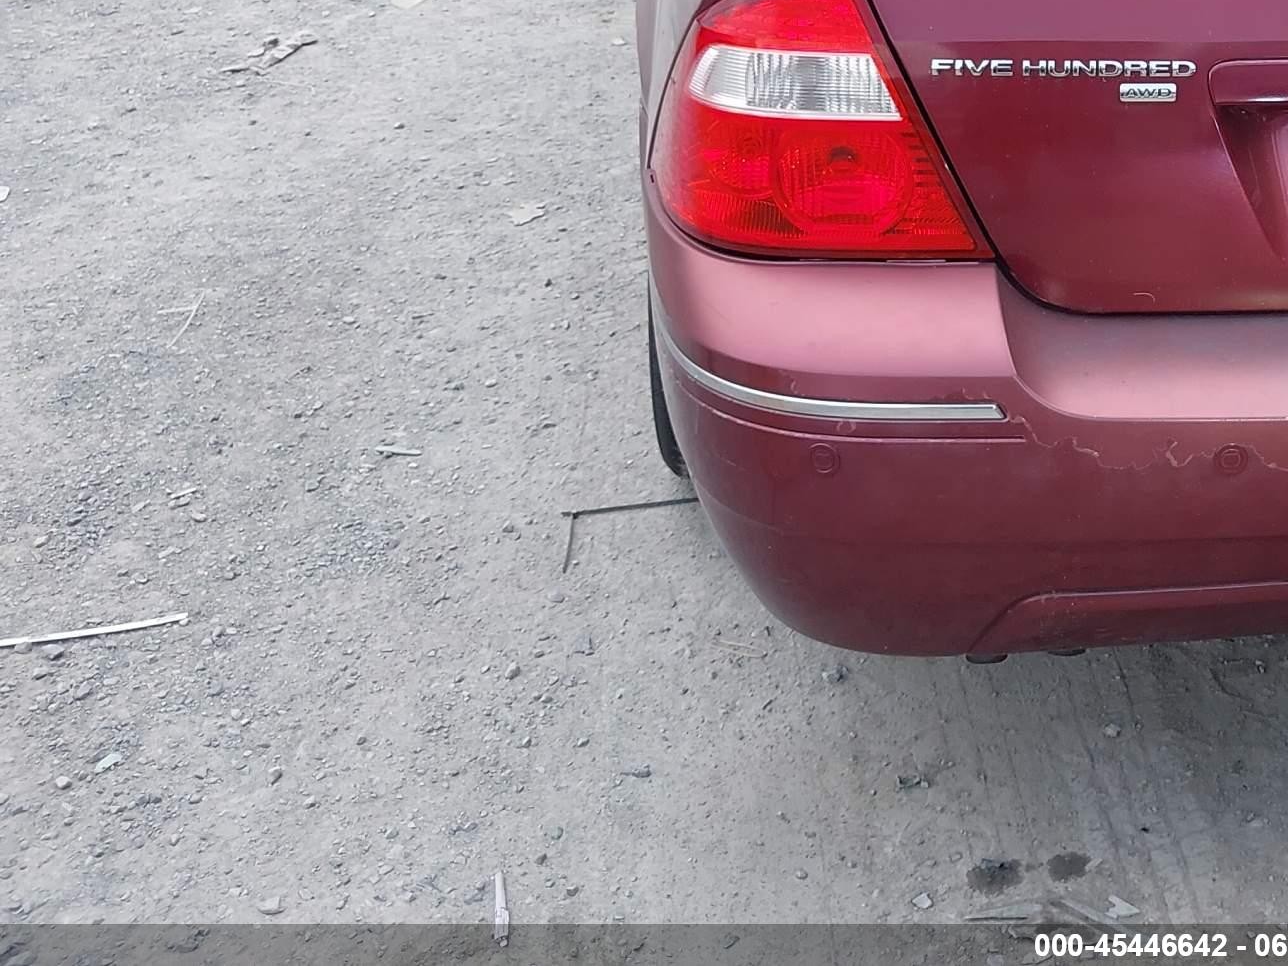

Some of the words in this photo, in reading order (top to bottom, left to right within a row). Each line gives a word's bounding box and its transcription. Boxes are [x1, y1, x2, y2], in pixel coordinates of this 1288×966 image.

[929, 59, 1014, 77] FIVE
[1022, 59, 1197, 78] HUNDRED
[1122, 86, 1173, 99] AWD
